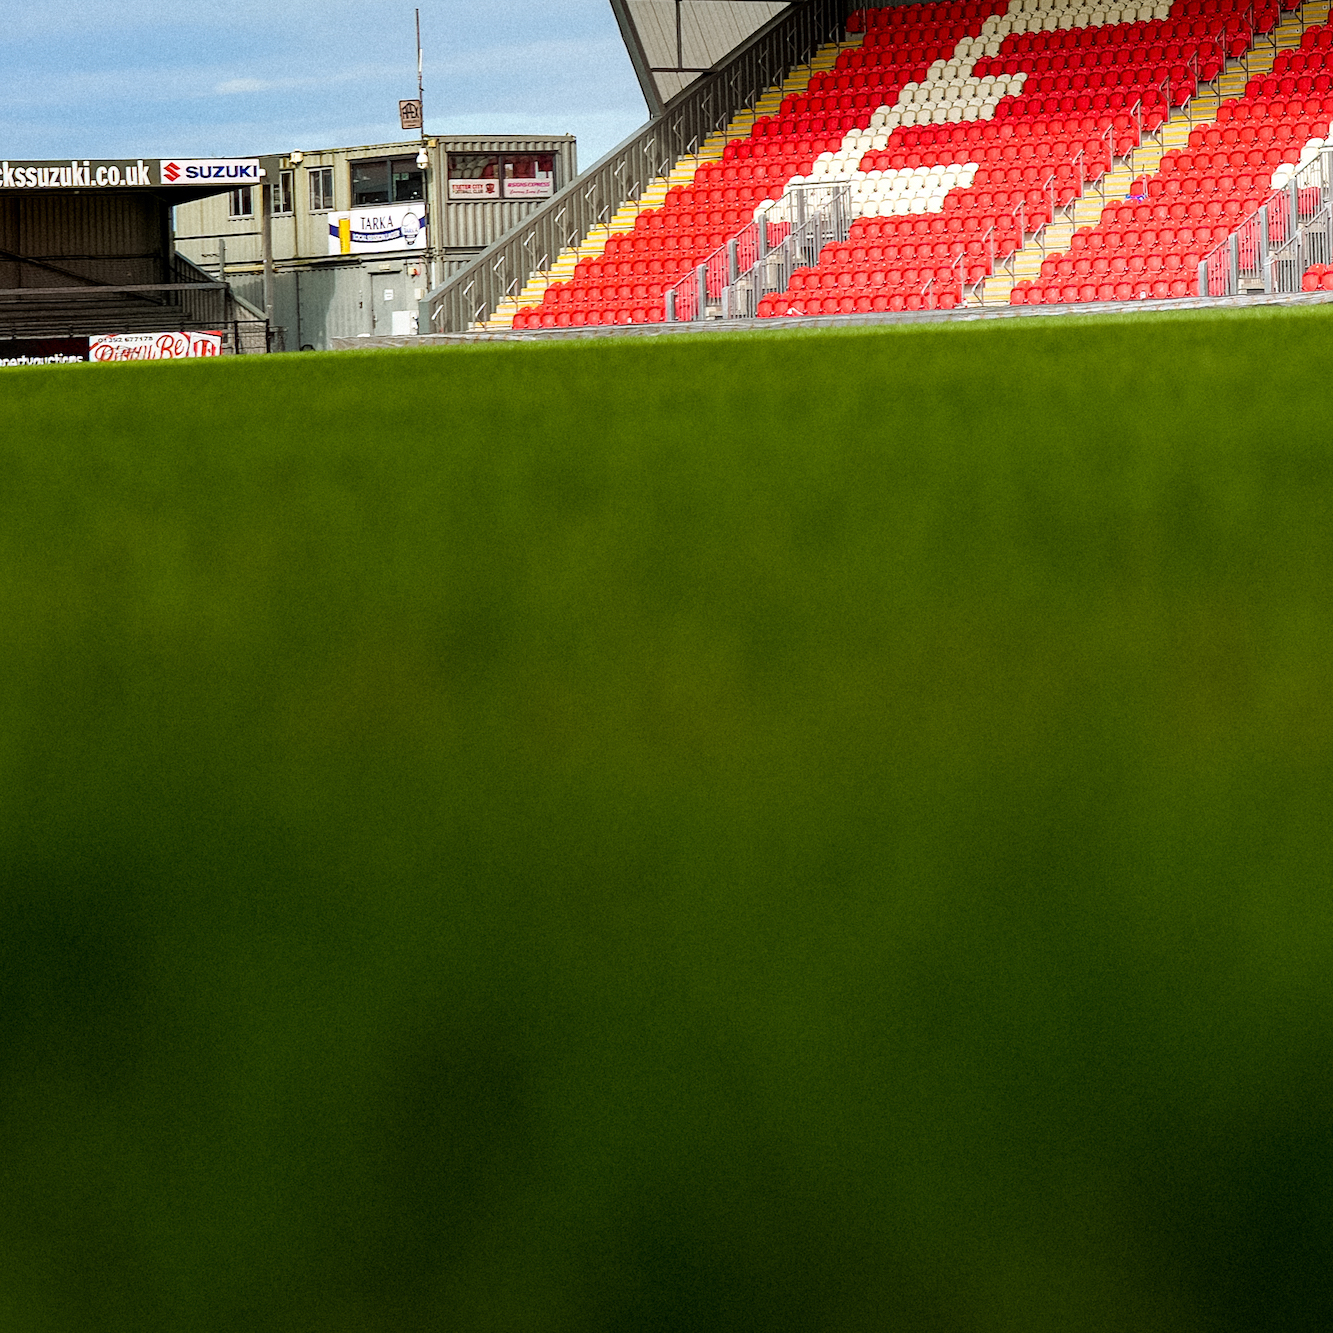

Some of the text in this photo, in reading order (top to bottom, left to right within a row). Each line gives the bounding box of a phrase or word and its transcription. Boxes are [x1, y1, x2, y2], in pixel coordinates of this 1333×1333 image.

[0, 160, 151, 188] kssuzuki.co.uk
[186, 165, 258, 179] SUZUKI
[360, 215, 394, 230] TARKA
